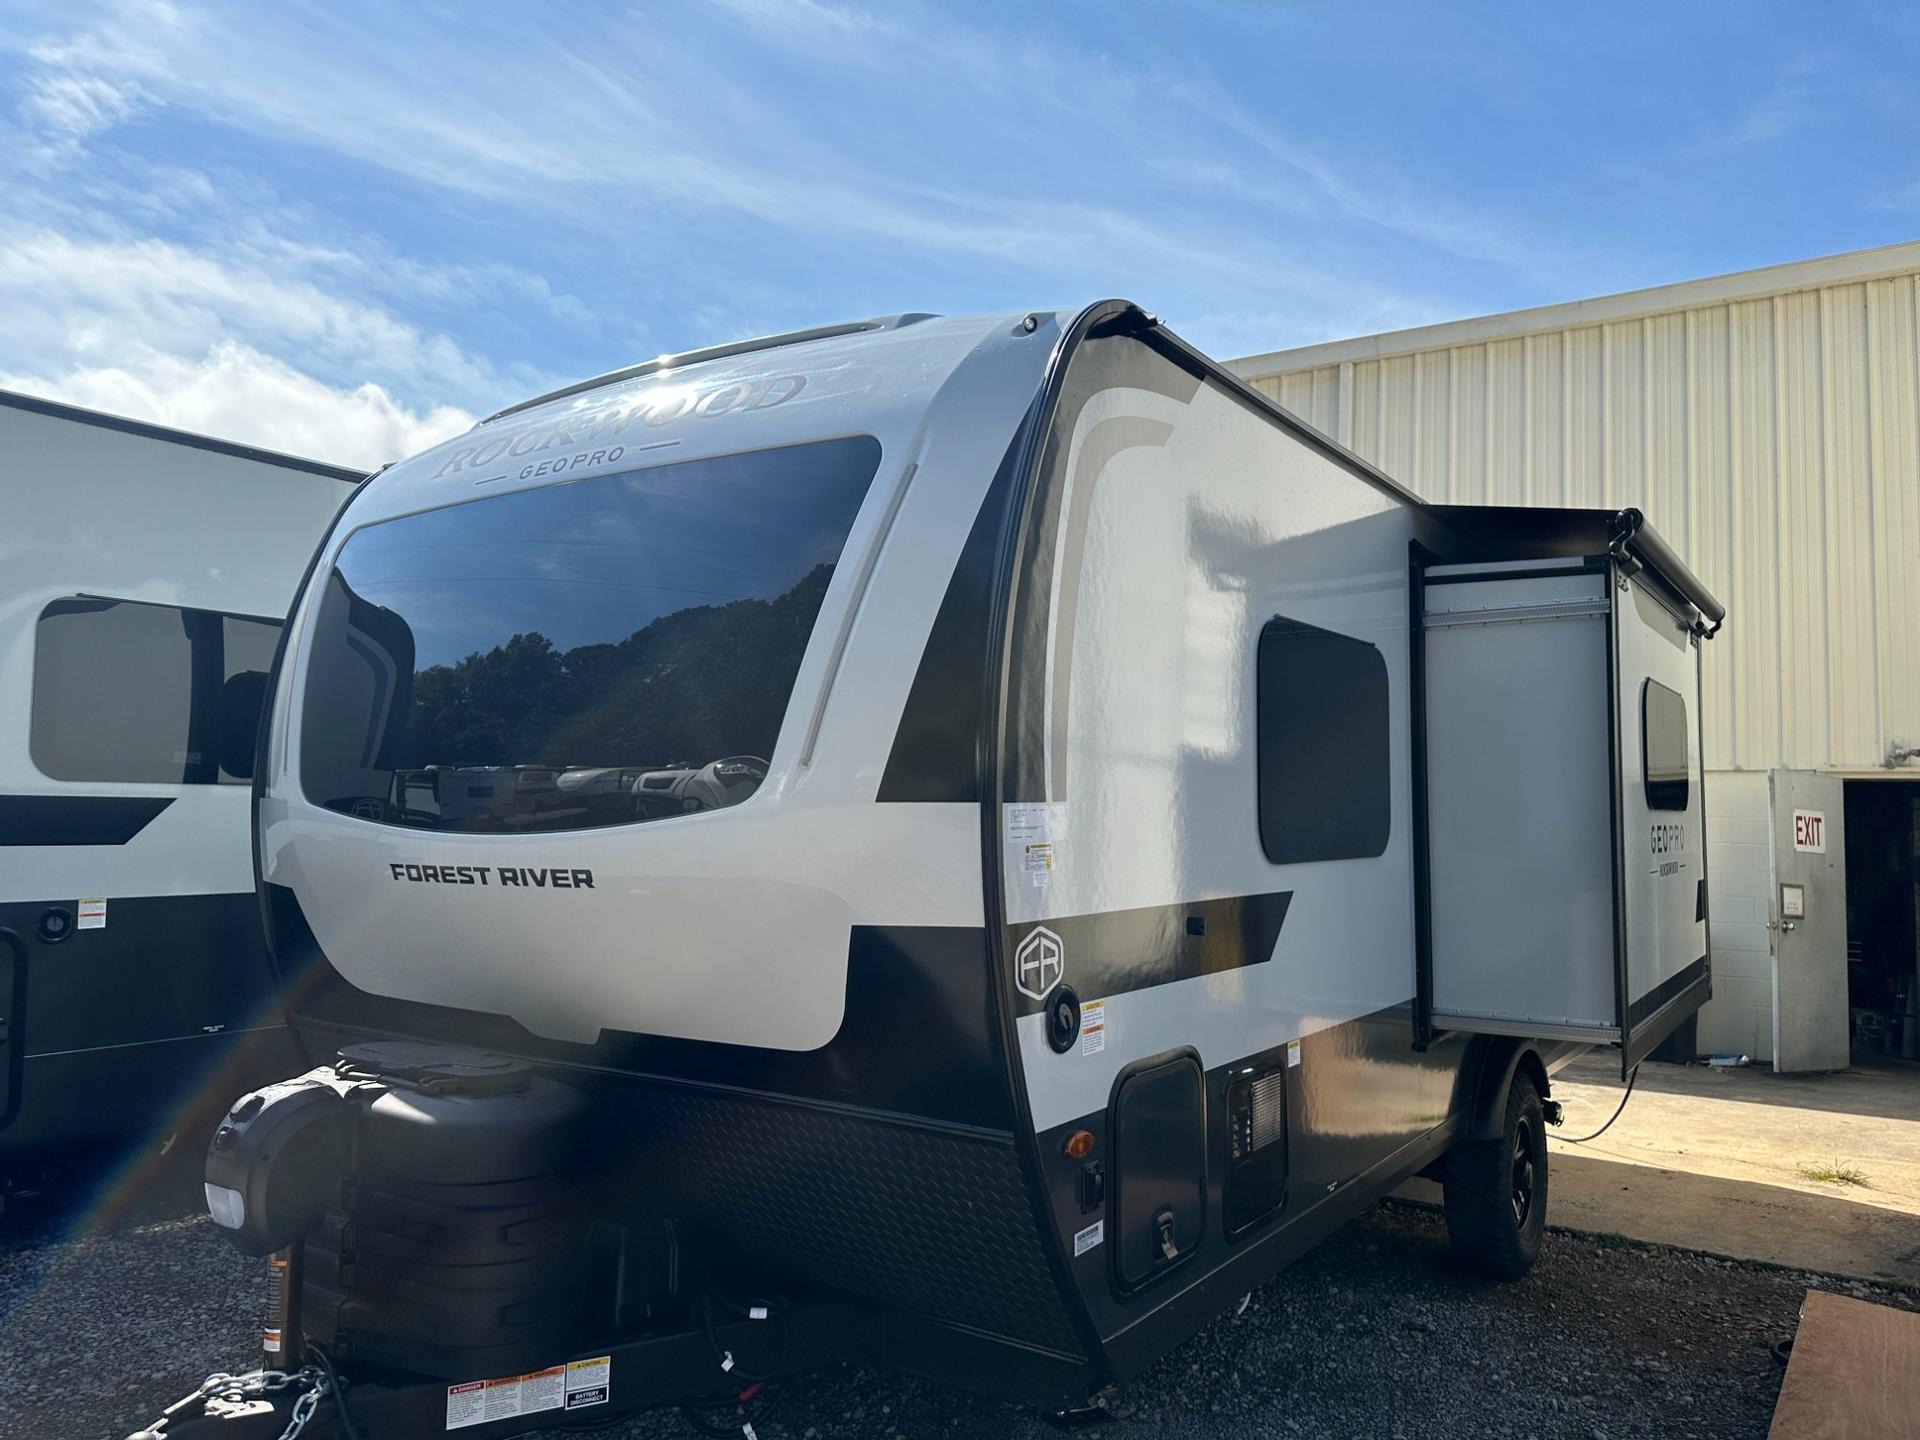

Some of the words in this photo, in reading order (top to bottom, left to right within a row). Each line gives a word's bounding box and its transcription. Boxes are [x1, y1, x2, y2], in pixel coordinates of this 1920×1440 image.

[518, 446, 625, 481] GEOPRO
[1651, 824, 1684, 854] GEOPRO
[1796, 815, 1822, 846] EXIT
[389, 863, 491, 886] FOREST
[497, 867, 595, 888] RIVER
[575, 1390, 600, 1400] BATTERY
